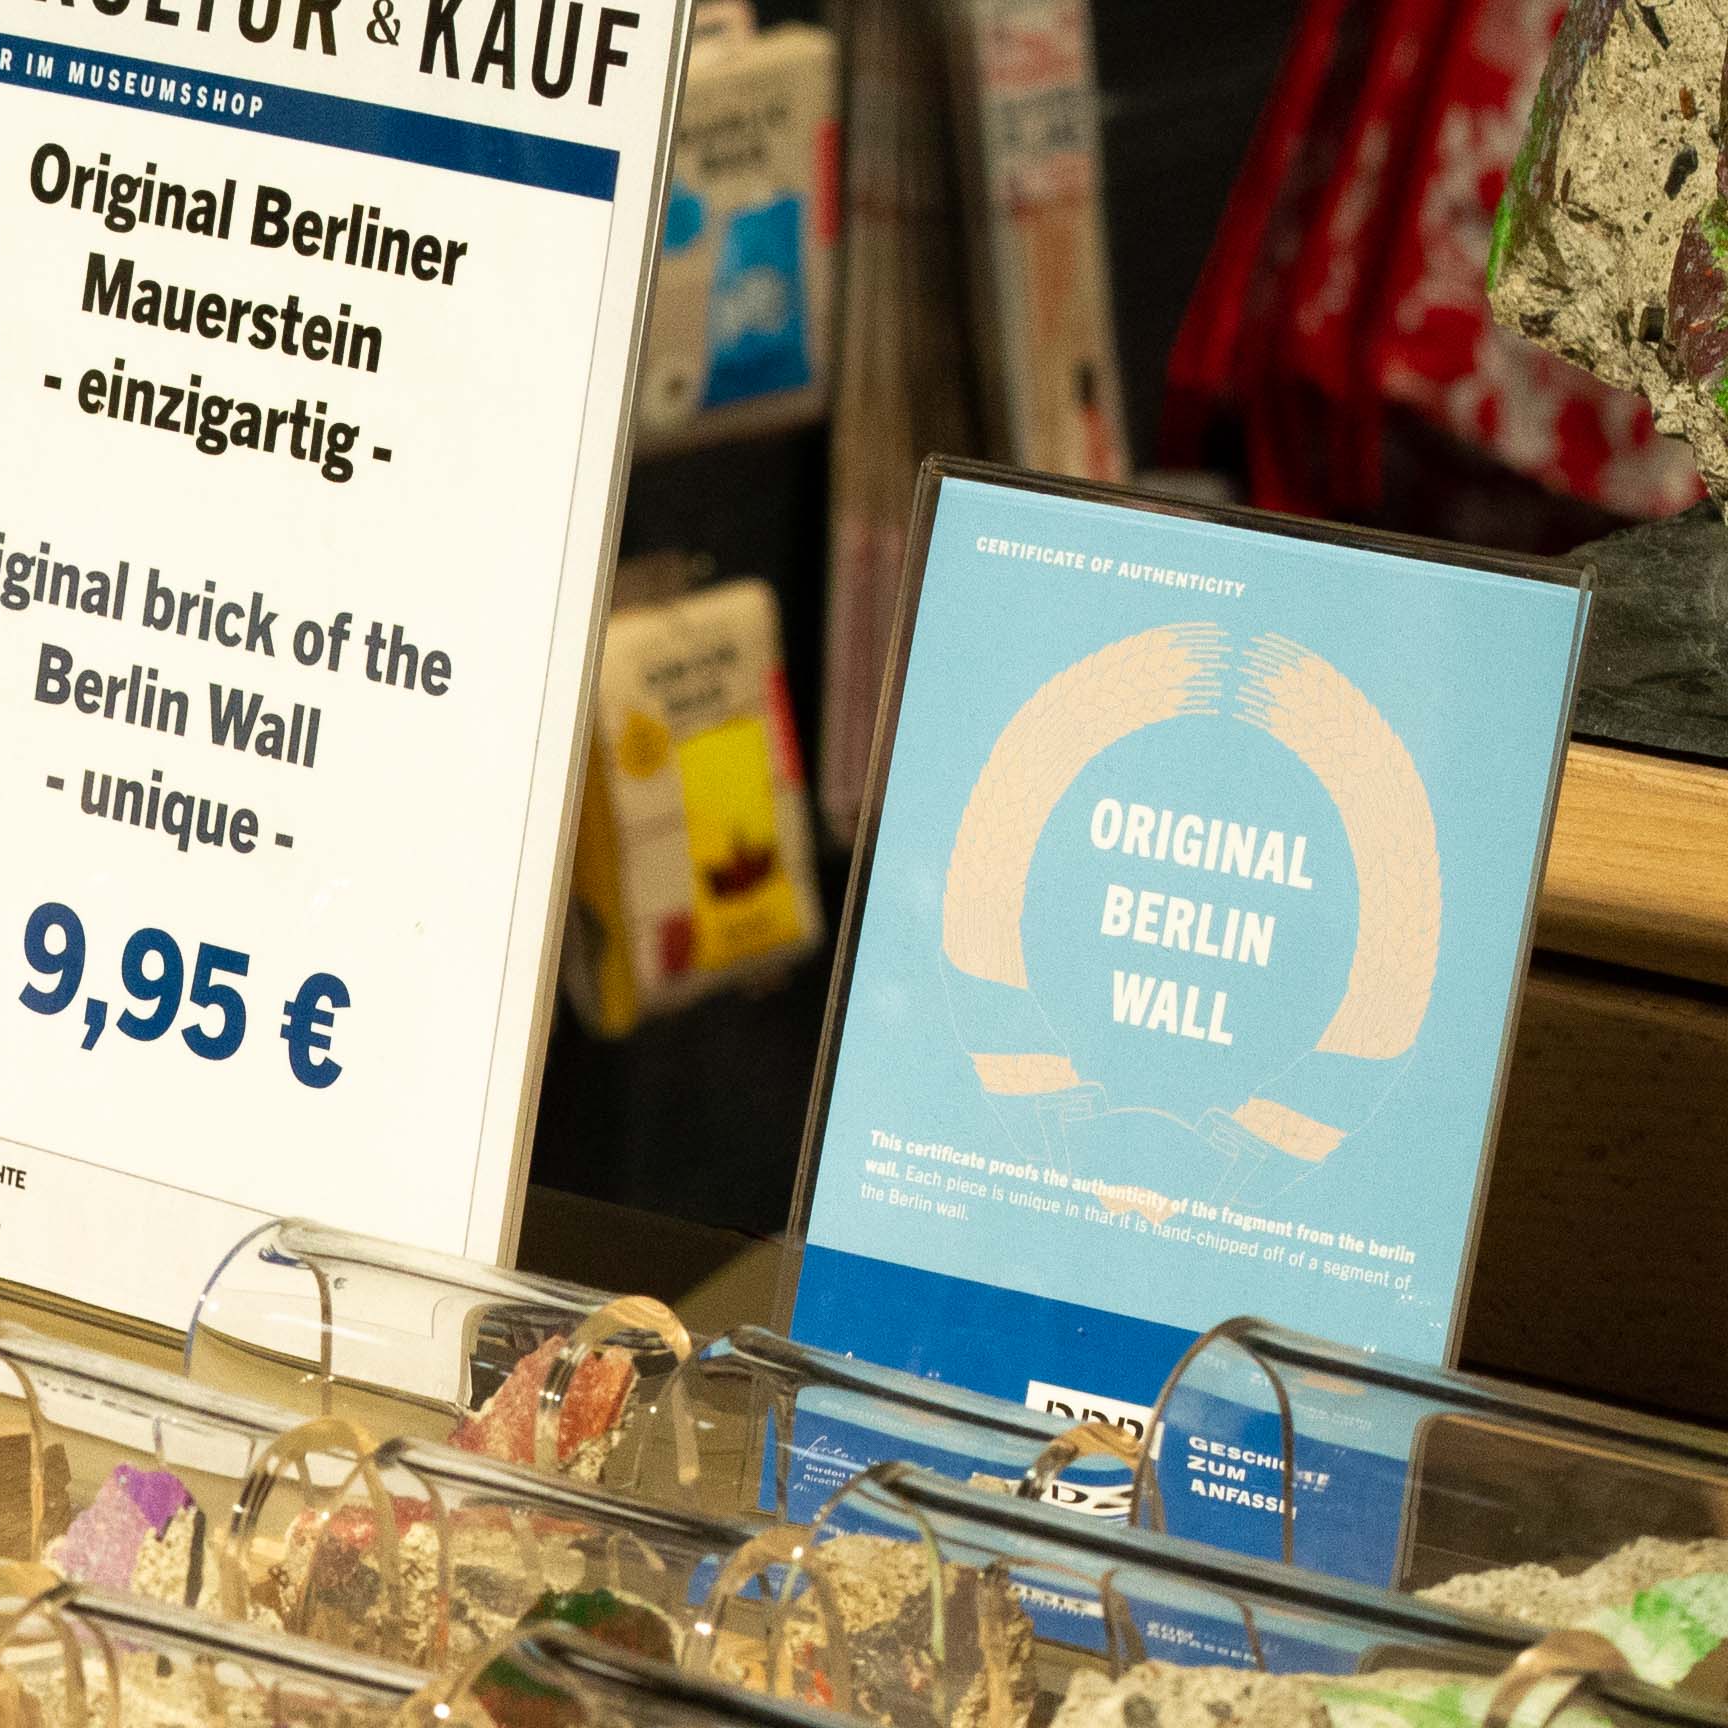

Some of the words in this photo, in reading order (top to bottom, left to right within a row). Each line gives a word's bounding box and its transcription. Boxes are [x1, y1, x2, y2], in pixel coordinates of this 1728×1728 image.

[26, 53, 55, 79] IM
[68, 61, 265, 119] MUSEUMSSHOP
[366, 0, 401, 46] &
[420, 0, 641, 107] KAUF
[30, 143, 236, 240] Original
[251, 185, 468, 285] Berliner
[82, 253, 382, 372] Mauerstein
[79, 358, 361, 483] einzigartig
[976, 536, 1086, 570] CERTIFICATE
[1090, 558, 1114, 573] OF
[1117, 562, 1245, 598] AUTHENTICITY
[143, 568, 278, 656] brick
[294, 613, 353, 671] of
[365, 622, 451, 696] the
[35, 643, 188, 736] Berlin
[210, 684, 320, 767] Wall
[82, 770, 259, 854] unique
[1091, 797, 1314, 891] ORIGINAL
[1101, 884, 1276, 967] BERLIN
[19, 903, 250, 1061] 9,95
[280, 973, 351, 1089] €
[1111, 969, 1235, 1047] WALL
[860, 1183, 884, 1202] the
[888, 1188, 932, 1212] Berlin
[936, 1201, 970, 1222] wall.
[864, 1157, 900, 1179] wall.
[905, 1165, 942, 1188] Each
[944, 1174, 988, 1198] piece
[993, 1184, 1004, 1202] is
[1009, 1191, 1061, 1214] unique
[1065, 1199, 1079, 1218] in
[1085, 1205, 1115, 1227] that
[1119, 1211, 1130, 1229] it
[1135, 1216, 1146, 1232] is
[1152, 1221, 1259, 1257] hand-chipped
[1263, 1245, 1286, 1264] off
[1288, 1250, 1305, 1267] of
[1308, 1256, 1318, 1270] a
[1323, 1260, 1390, 1287] segment
[1394, 1273, 1413, 1292] of
[871, 1129, 902, 1151] This
[906, 1141, 985, 1171] certificate
[988, 1159, 1040, 1182] proofs
[1043, 1168, 1069, 1189] the
[1072, 1177, 1169, 1212] authenticity
[1171, 1198, 1189, 1214] of
[1191, 1200, 1217, 1221] the
[1221, 1205, 1293, 1237] fragment
[1296, 1224, 1334, 1246] from
[1338, 1232, 1366, 1256] the
[1369, 1239, 1416, 1264] berlin
[802, 1473, 846, 1489] Directo
[1187, 1455, 1247, 1483] ZUM
